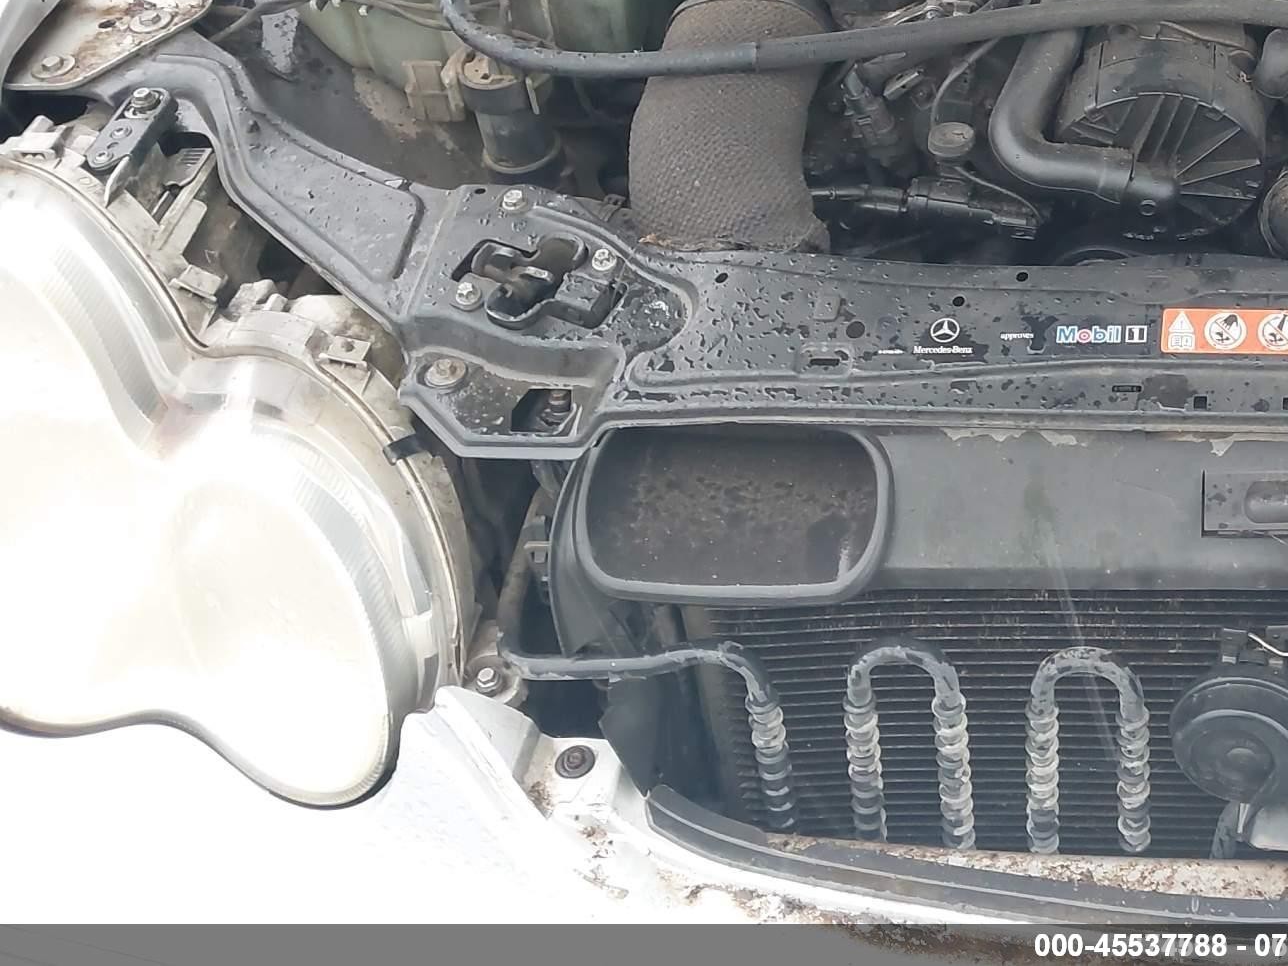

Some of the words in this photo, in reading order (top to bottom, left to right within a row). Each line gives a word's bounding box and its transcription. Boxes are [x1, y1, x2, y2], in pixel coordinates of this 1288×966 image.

[999, 331, 1035, 342] approves
[1055, 324, 1122, 344] Mobil
[912, 345, 974, 355] Mercedes-Benz
